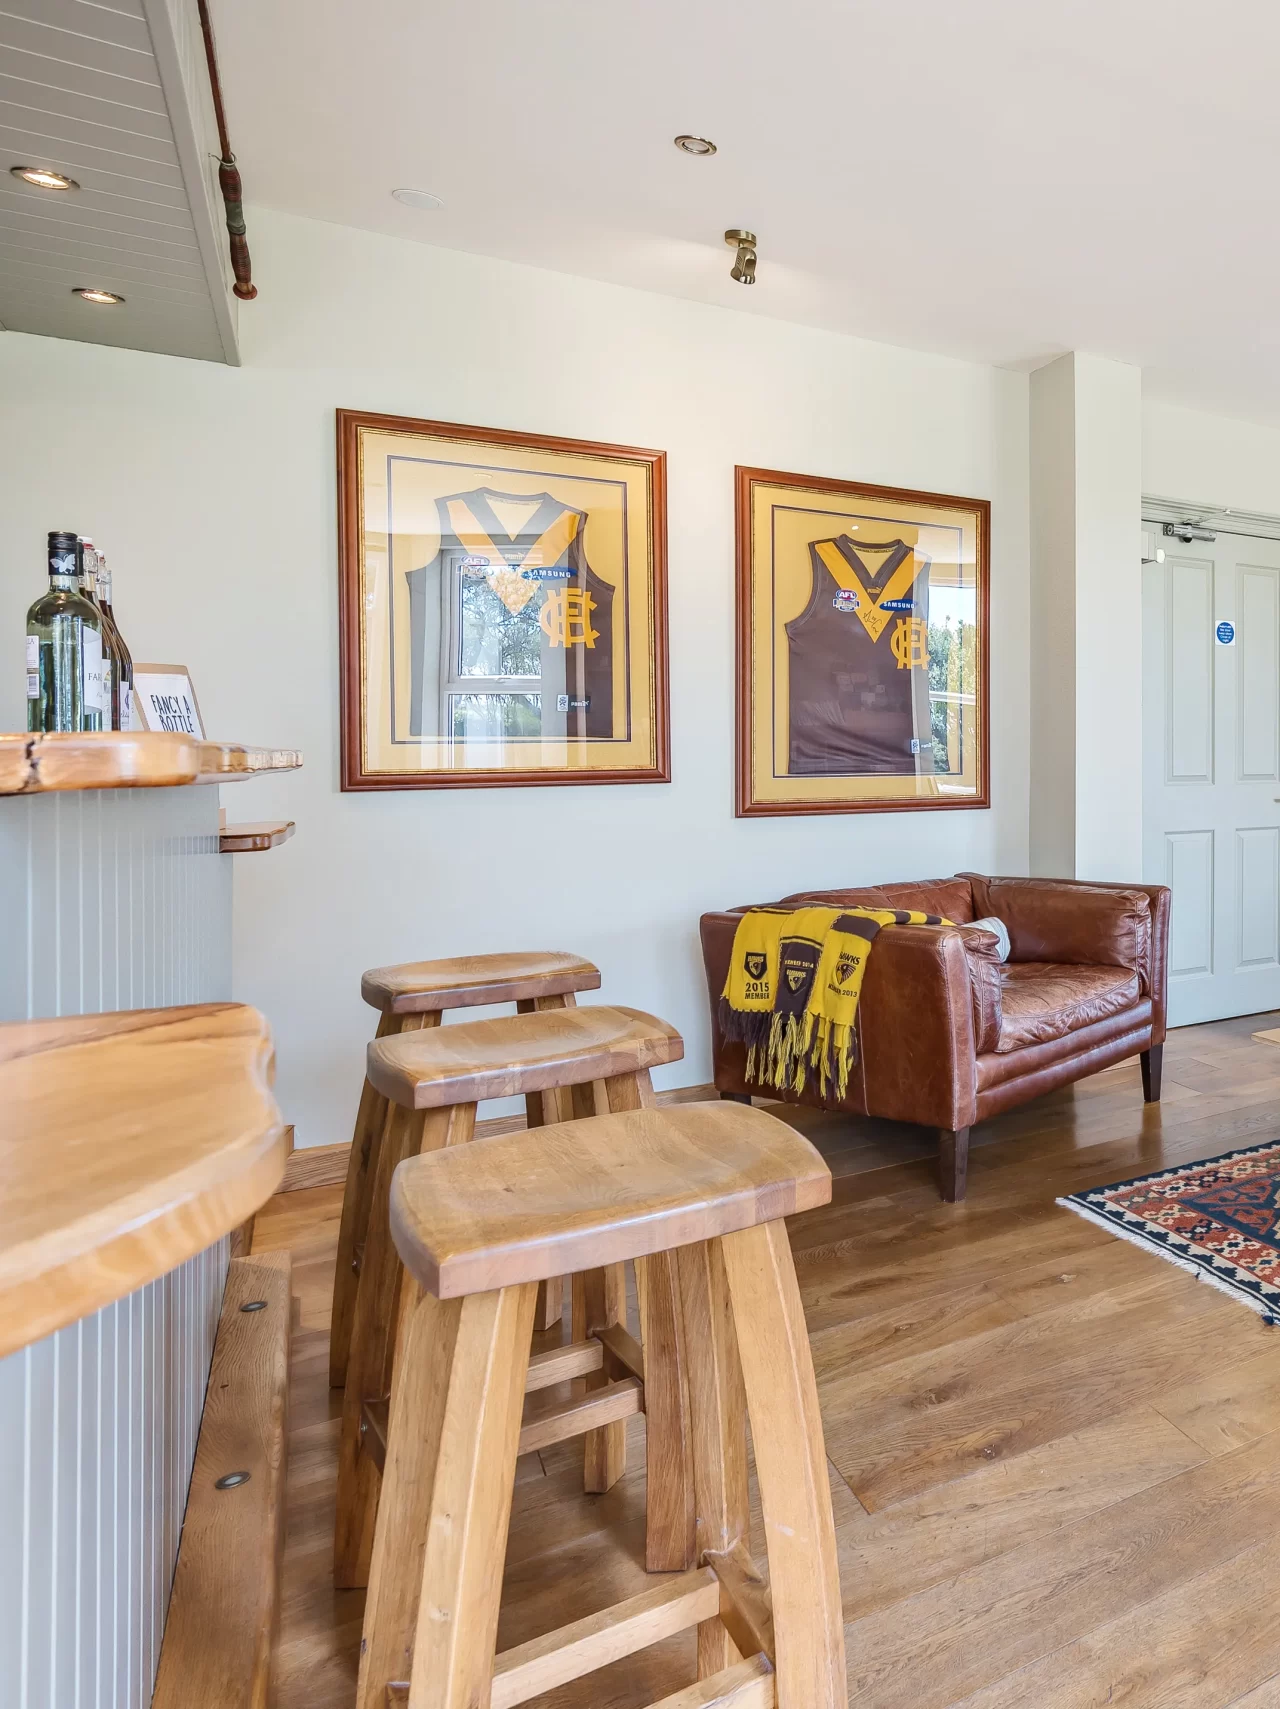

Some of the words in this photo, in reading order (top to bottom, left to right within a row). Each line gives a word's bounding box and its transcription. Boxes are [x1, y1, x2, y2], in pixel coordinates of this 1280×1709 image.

[464, 557, 488, 565] AFL
[527, 569, 571, 578] SAMSUNG
[883, 601, 914, 609] SAMSUNG
[150, 695, 182, 715] FANCY
[183, 695, 191, 714] A
[159, 715, 194, 733] BOTTLE
[745, 982, 770, 992] 2015
[842, 989, 858, 998] 2013
